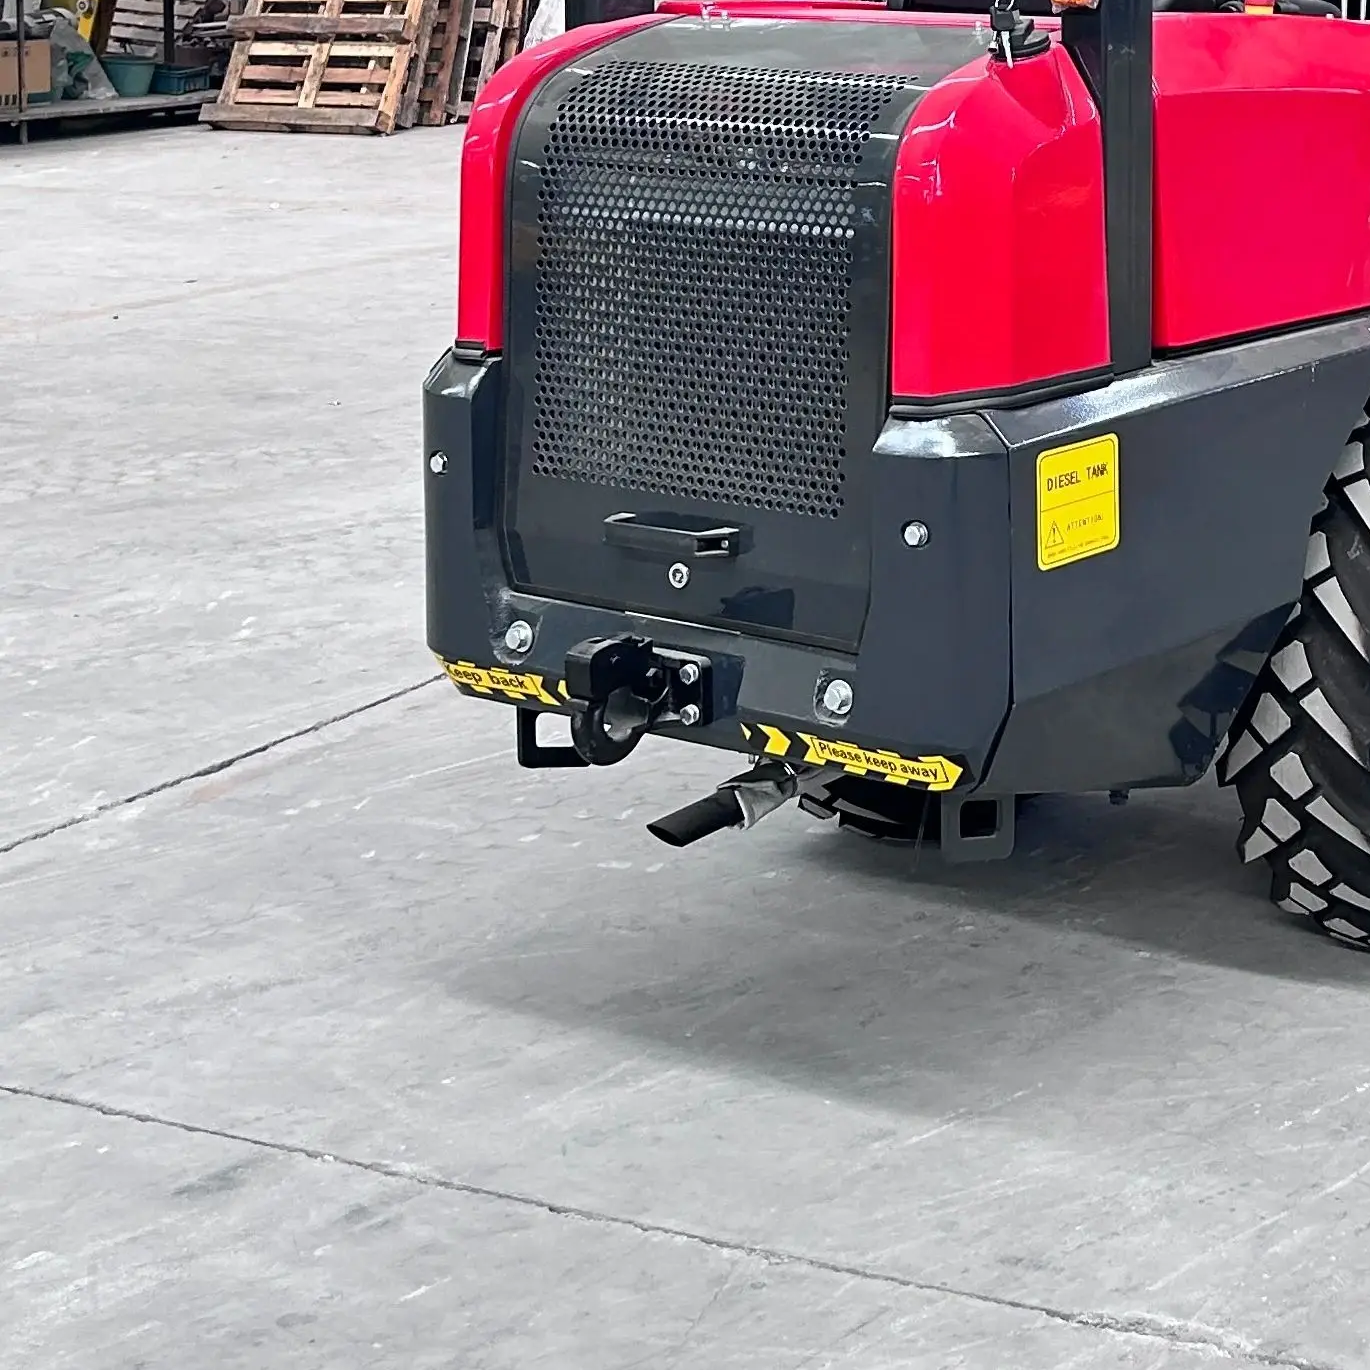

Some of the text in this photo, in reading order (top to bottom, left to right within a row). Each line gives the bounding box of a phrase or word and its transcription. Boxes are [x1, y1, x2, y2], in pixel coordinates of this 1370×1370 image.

[1046, 462, 1109, 492] DIESEL TANK
[487, 671, 529, 690] back
[818, 741, 939, 781] Please keep away
